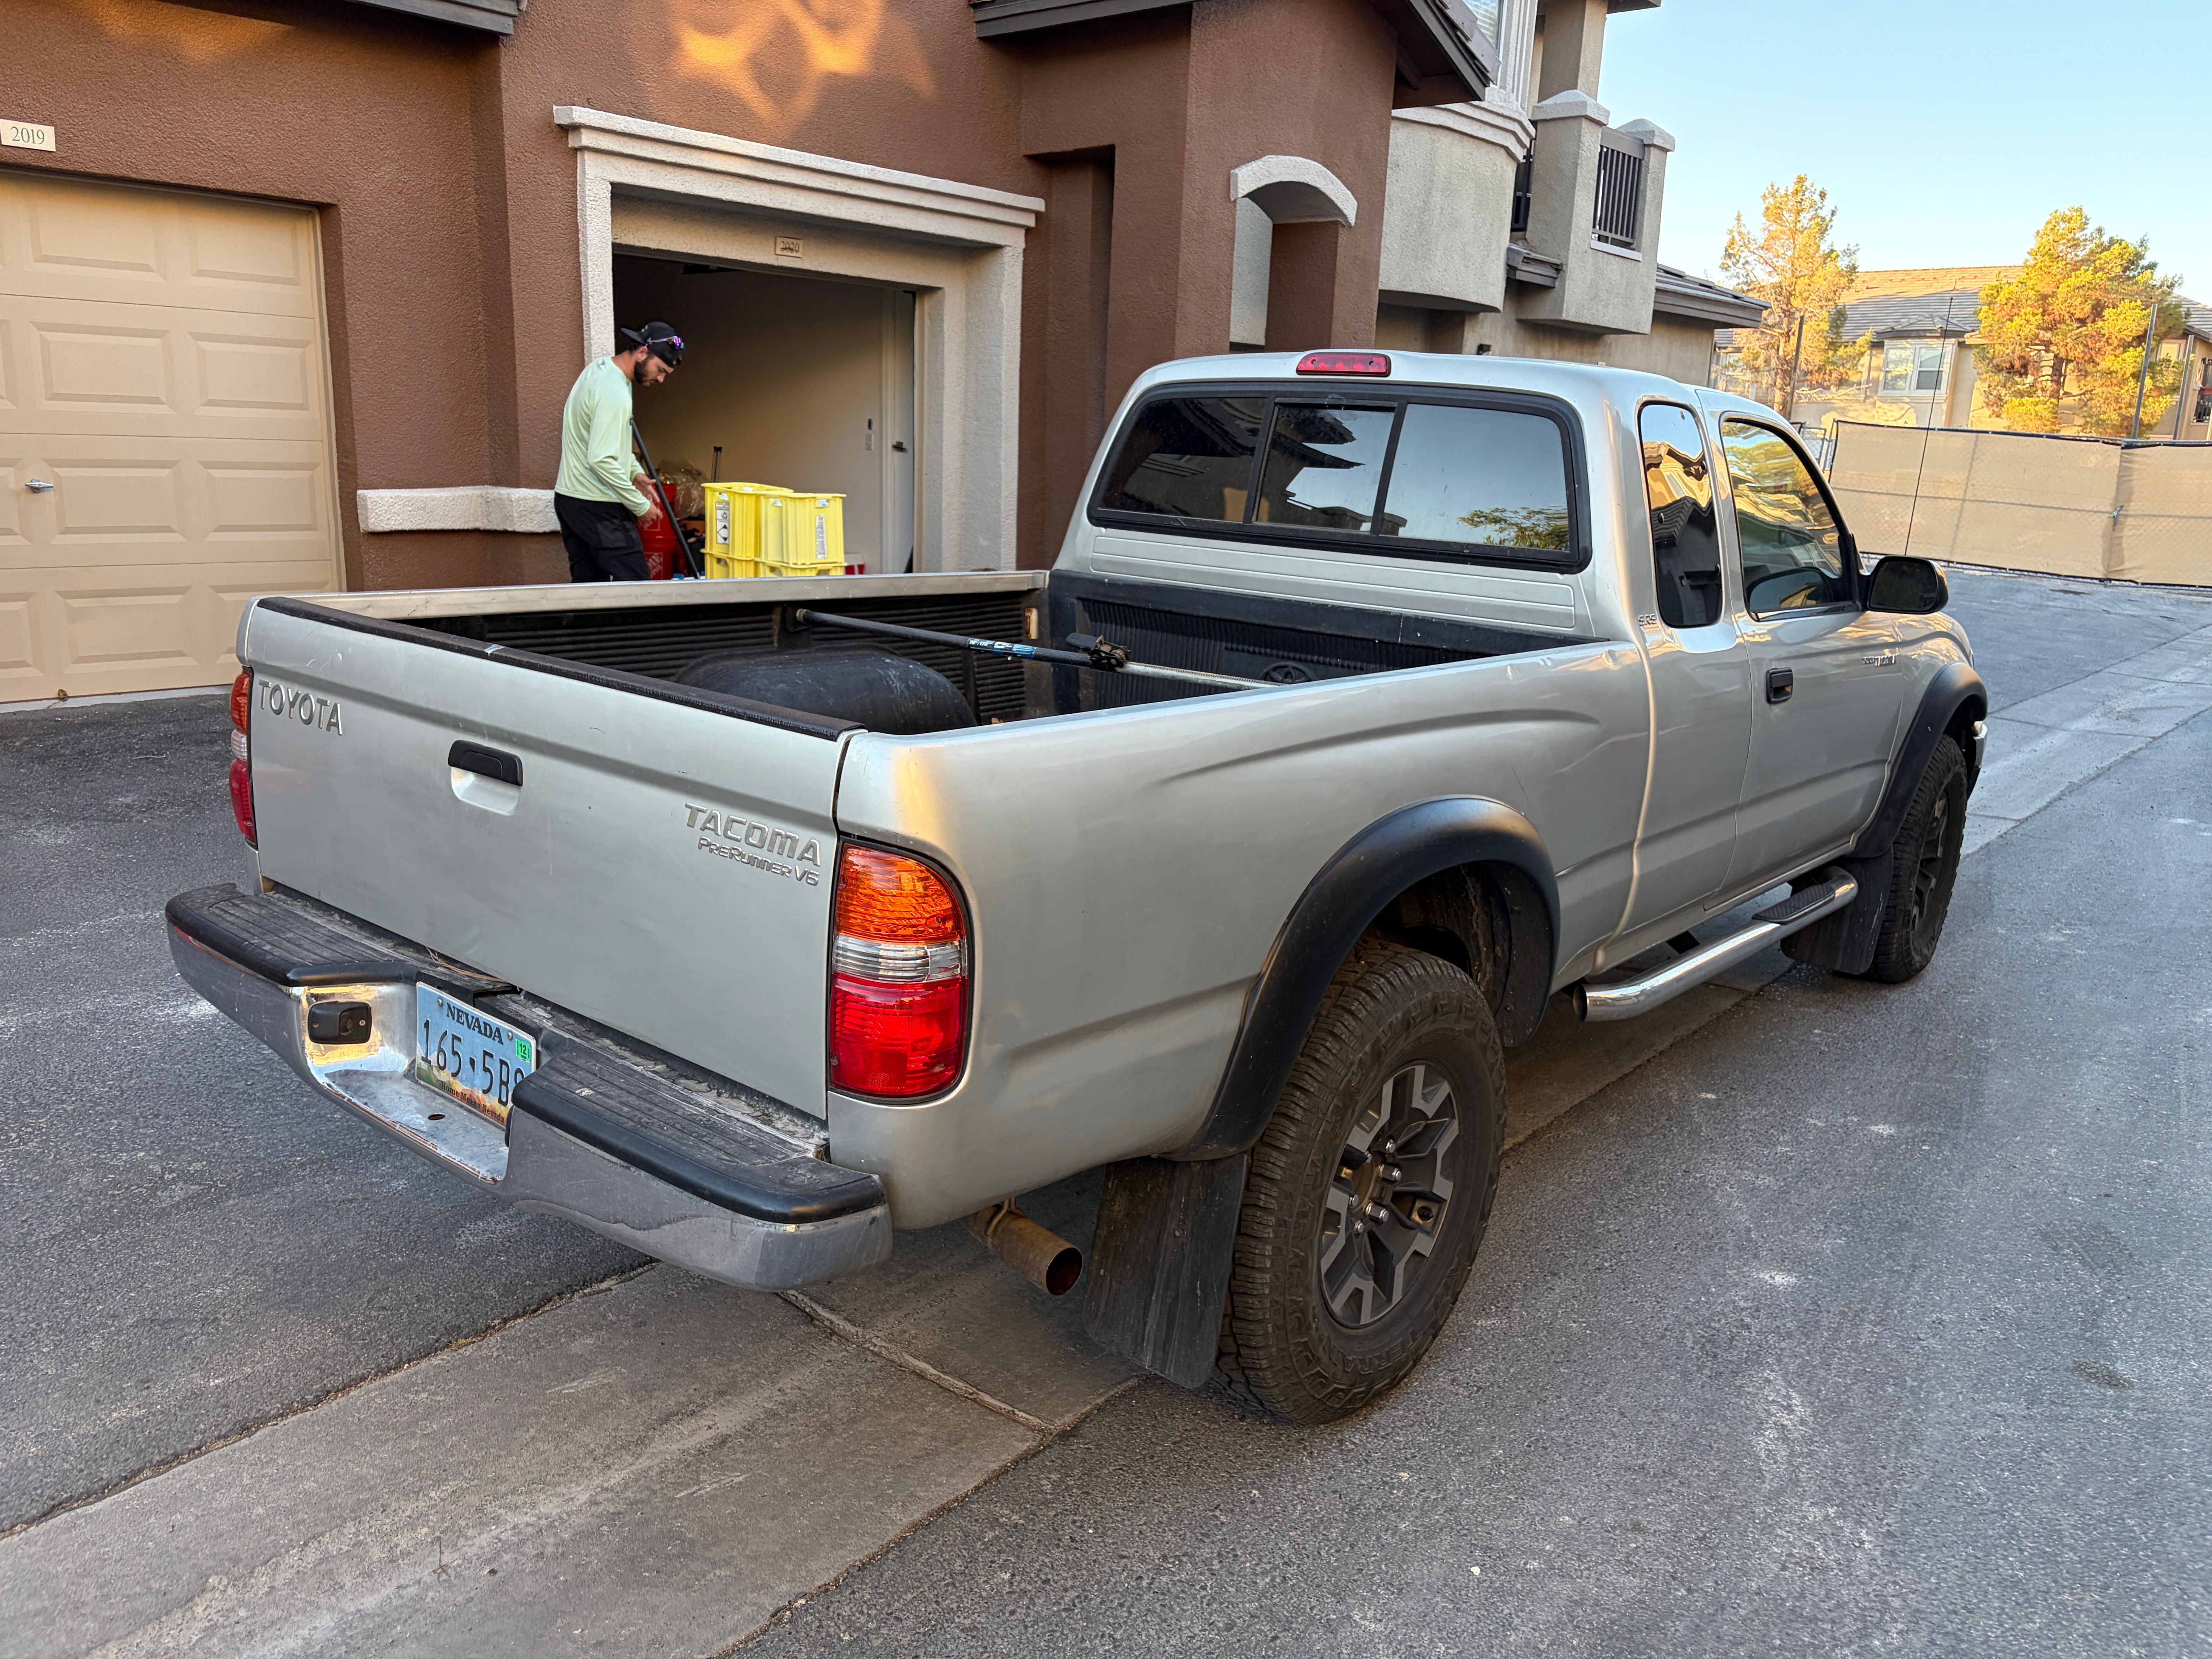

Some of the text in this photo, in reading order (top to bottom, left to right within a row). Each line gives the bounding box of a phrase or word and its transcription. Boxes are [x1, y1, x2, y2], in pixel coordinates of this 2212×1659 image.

[11, 126, 45, 144] 2019
[780, 241, 799, 254] 2020
[259, 679, 343, 736] TOYOTA
[685, 802, 821, 867] TACOMA
[794, 865, 820, 886] V6
[446, 1002, 504, 1045] NEVADA
[519, 1043, 527, 1055] 12
[441, 1081, 505, 1123] Home Means Nevada
